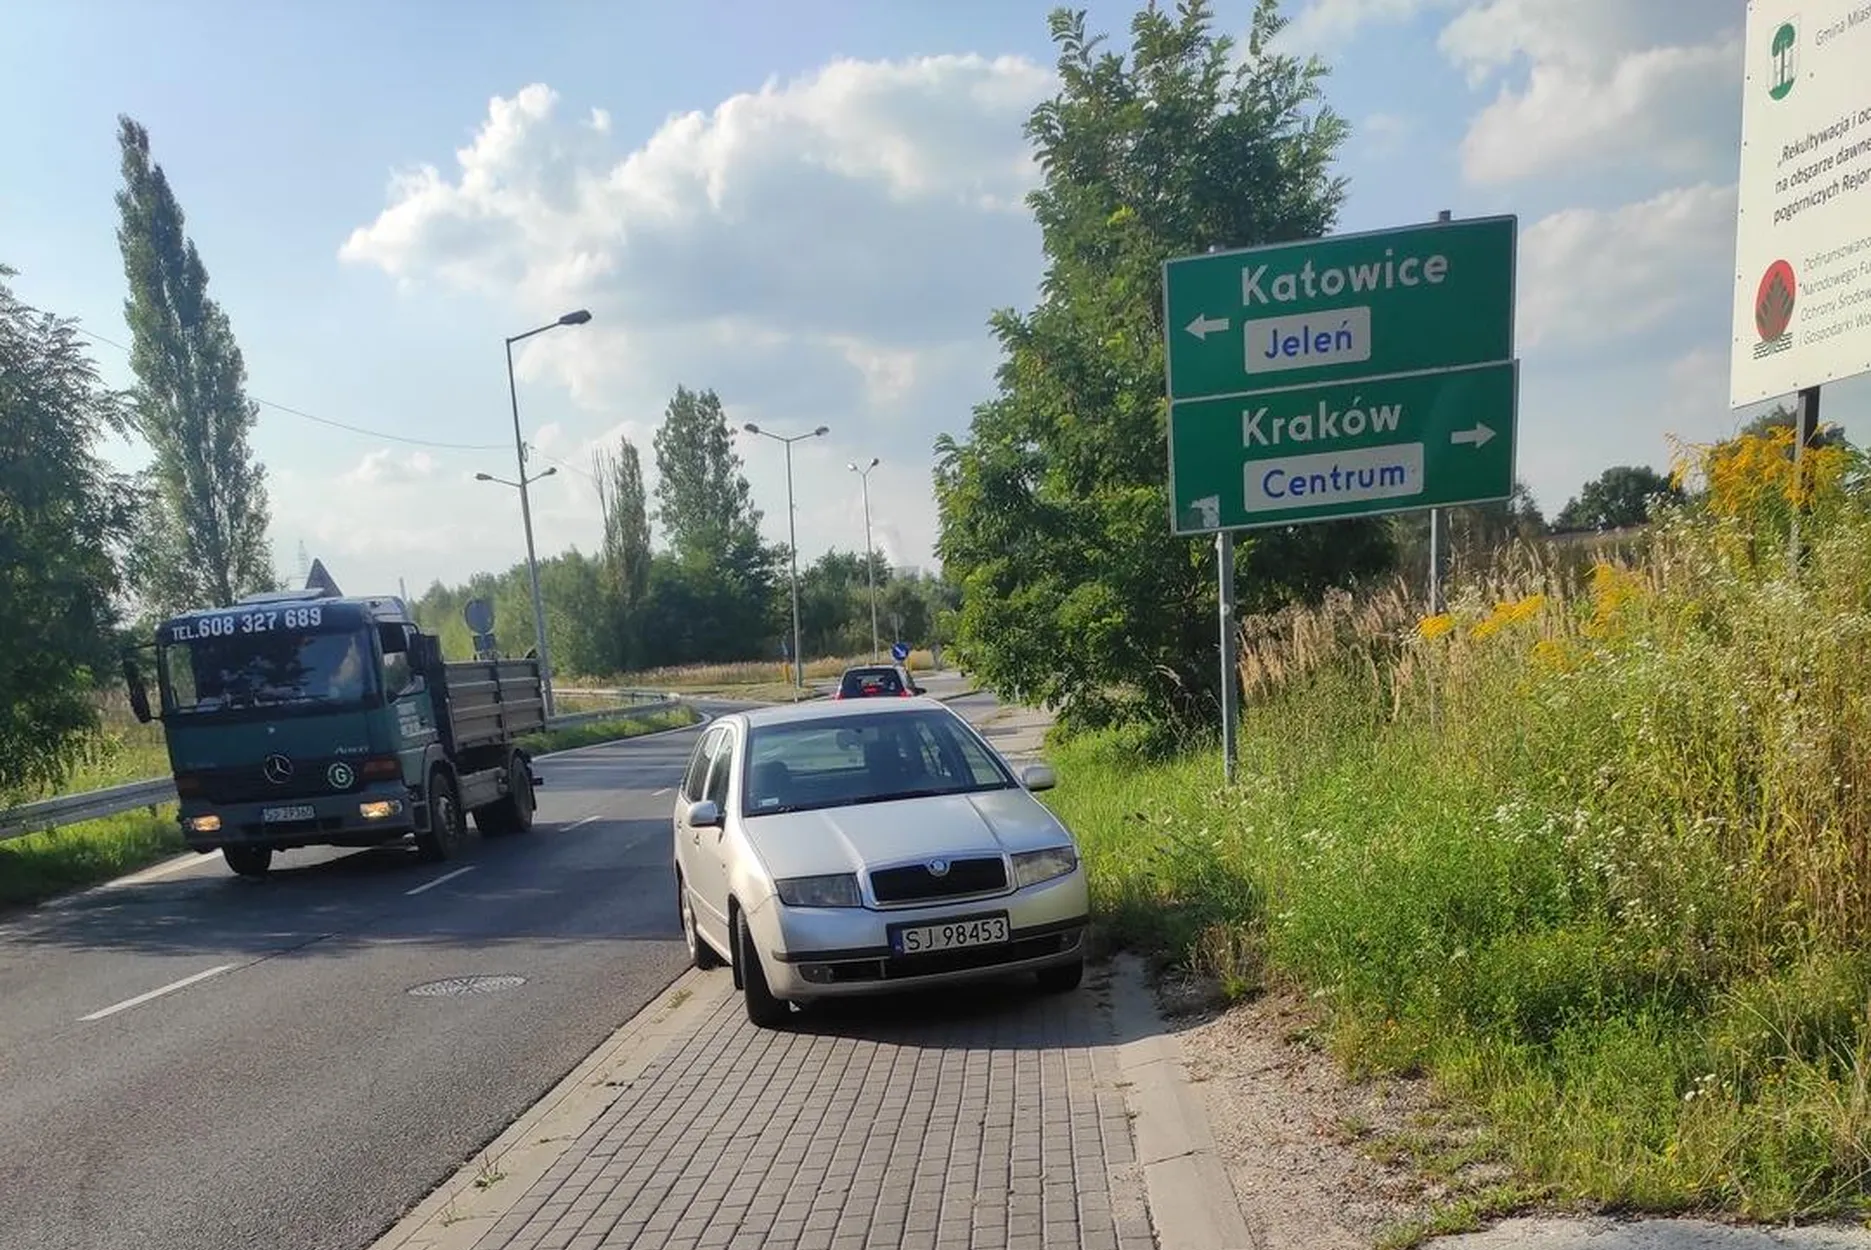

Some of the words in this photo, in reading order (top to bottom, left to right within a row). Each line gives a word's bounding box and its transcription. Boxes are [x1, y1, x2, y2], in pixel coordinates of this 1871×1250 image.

[1775, 178, 1788, 194] na
[1789, 156, 1833, 187] obszarze
[1242, 249, 1449, 306] Katowice
[1264, 320, 1353, 360] Jeleń
[1242, 396, 1402, 448] Kraków
[1262, 464, 1406, 499] Centrum
[241, 611, 277, 634] 327
[284, 606, 322, 629] 689
[905, 928, 934, 951] SJ
[942, 919, 1005, 947] 98453
